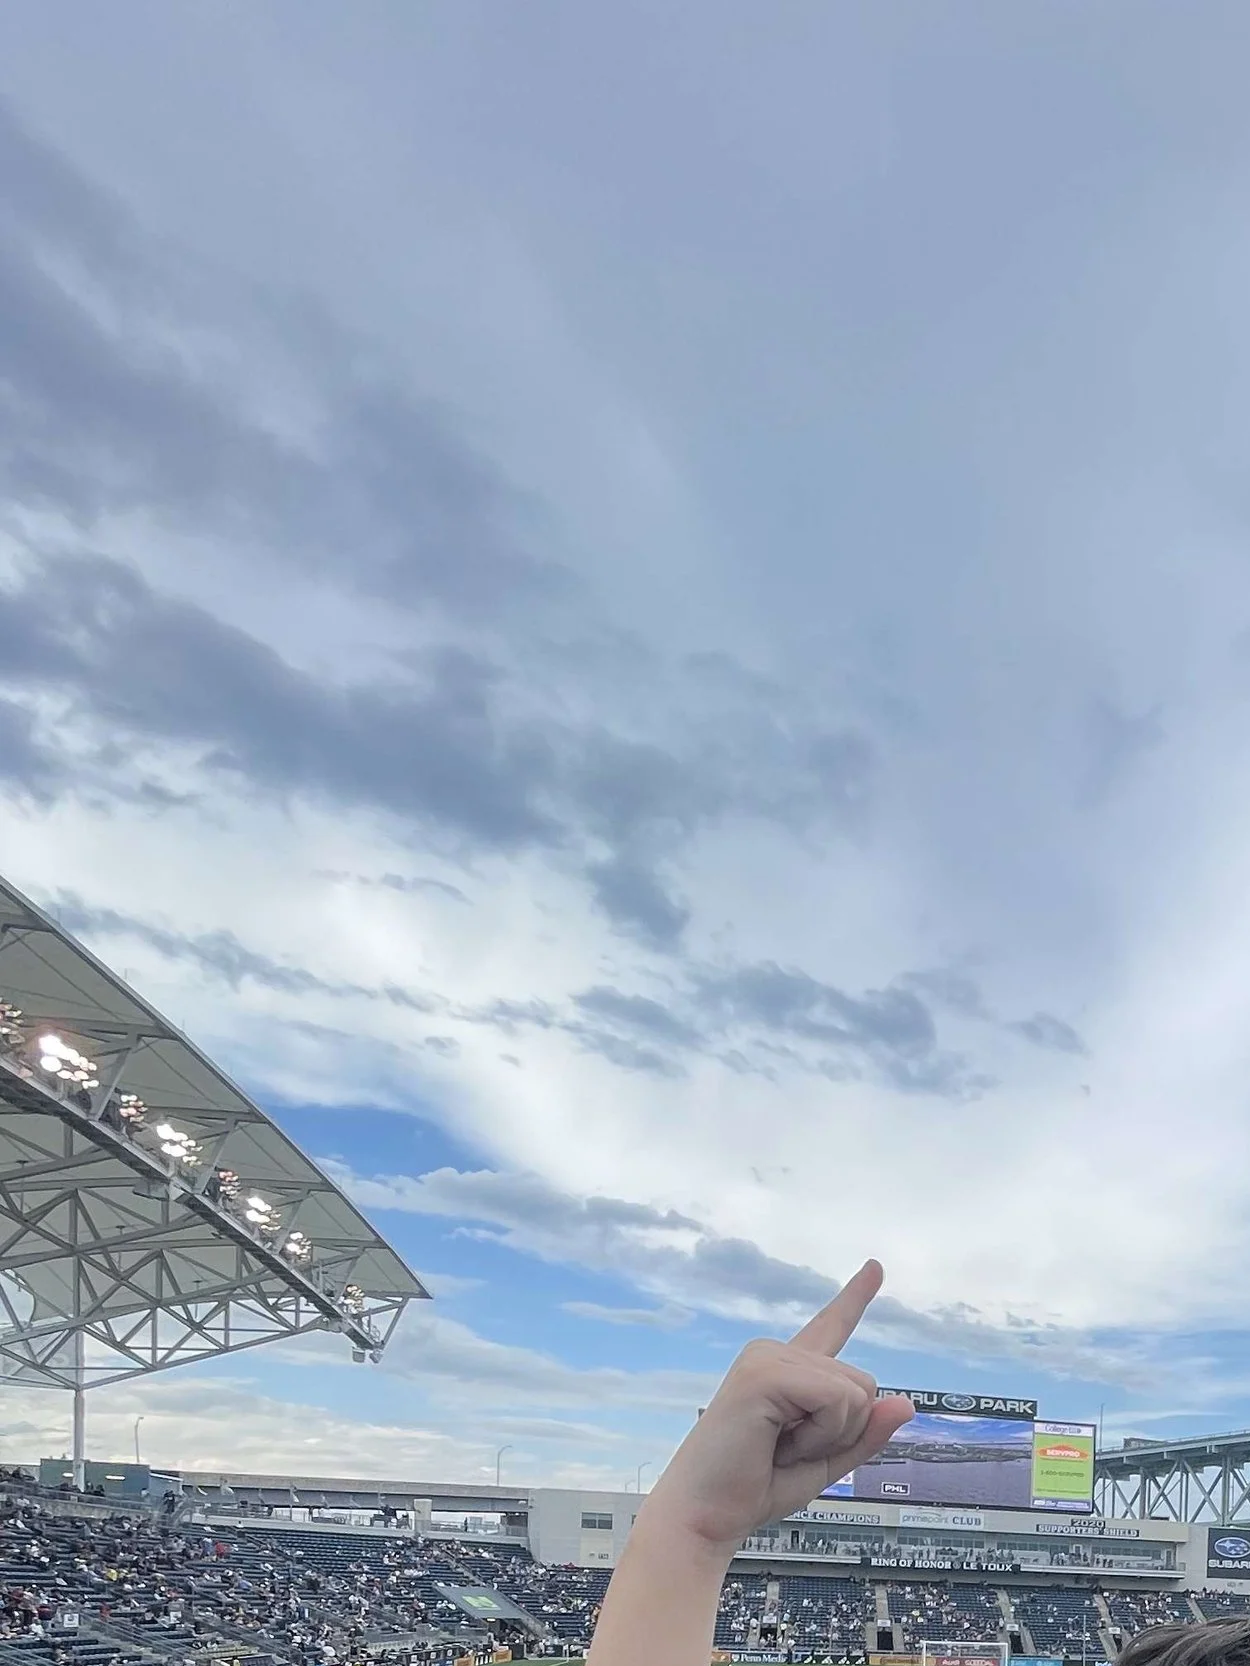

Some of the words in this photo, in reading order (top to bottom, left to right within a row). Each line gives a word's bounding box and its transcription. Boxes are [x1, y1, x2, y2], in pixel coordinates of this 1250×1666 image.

[980, 1398, 1034, 1414] PARK
[884, 1485, 907, 1493] PHL
[816, 1511, 880, 1523] CHAMPIONS
[952, 1516, 982, 1526] CLUB
[1073, 1519, 1104, 1528] 2020
[1103, 1528, 1138, 1538] SHIELD
[870, 1558, 897, 1568] RING
[899, 1558, 913, 1567] OF
[914, 1559, 952, 1570] HONOR
[963, 1561, 978, 1570] LE
[981, 1562, 1013, 1572] TOUX
[740, 1653, 762, 1662] Penn
